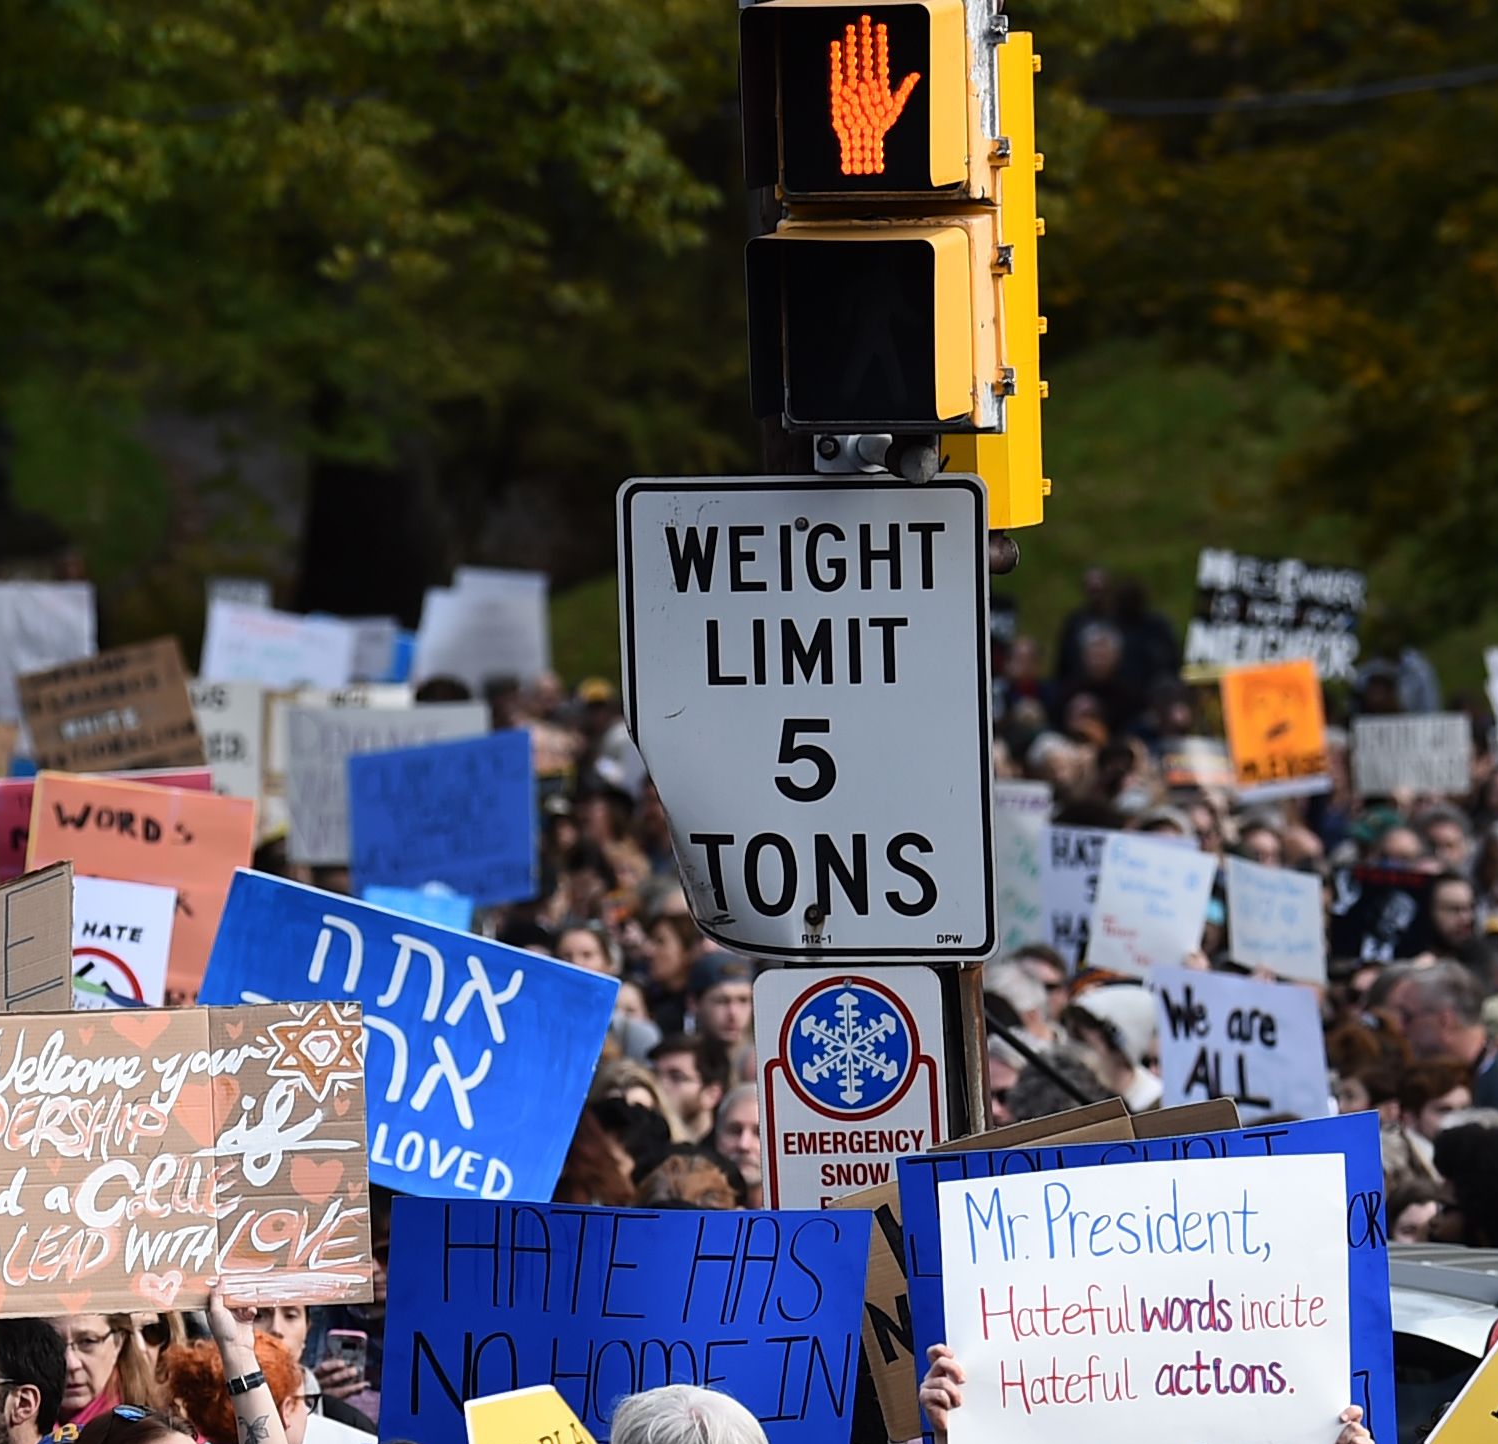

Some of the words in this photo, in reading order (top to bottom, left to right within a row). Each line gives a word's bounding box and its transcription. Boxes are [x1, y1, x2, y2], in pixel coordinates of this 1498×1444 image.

[665, 521, 944, 593] WEIGHT
[705, 617, 908, 687] LIMIT
[774, 718, 837, 803] 5
[54, 801, 193, 845] WORDS
[690, 831, 938, 918] TONS
[81, 921, 145, 944] HATE
[937, 934, 962, 945] DPW
[308, 914, 526, 1044] אתה
[1162, 985, 1210, 1040] We
[1228, 1007, 1276, 1048] are
[153, 1036, 273, 1115] your
[1185, 1047, 1272, 1107] ALL
[208, 1078, 343, 1187] if
[371, 1122, 513, 1201] LOVED
[783, 1127, 926, 1156] EMERGENCY
[43, 1185, 71, 1214] a
[820, 1160, 891, 1187] SNOW
[5, 1225, 117, 1287] LEAD
[125, 1222, 219, 1274] WITH
[215, 1197, 368, 1275] LOVE
[964, 1187, 1030, 1264] Mr.
[1043, 1179, 1271, 1263] President,
[443, 1204, 659, 1318] HATE
[683, 1216, 840, 1325] HAS
[980, 1284, 1135, 1342] Hateful
[1140, 1280, 1234, 1334] words
[1241, 1283, 1327, 1332] incite
[409, 1330, 518, 1416] NO
[549, 1337, 749, 1425] HOME
[759, 1332, 852, 1423] IN
[1000, 1355, 1138, 1414] Hateful
[1155, 1350, 1295, 1396] actions.
